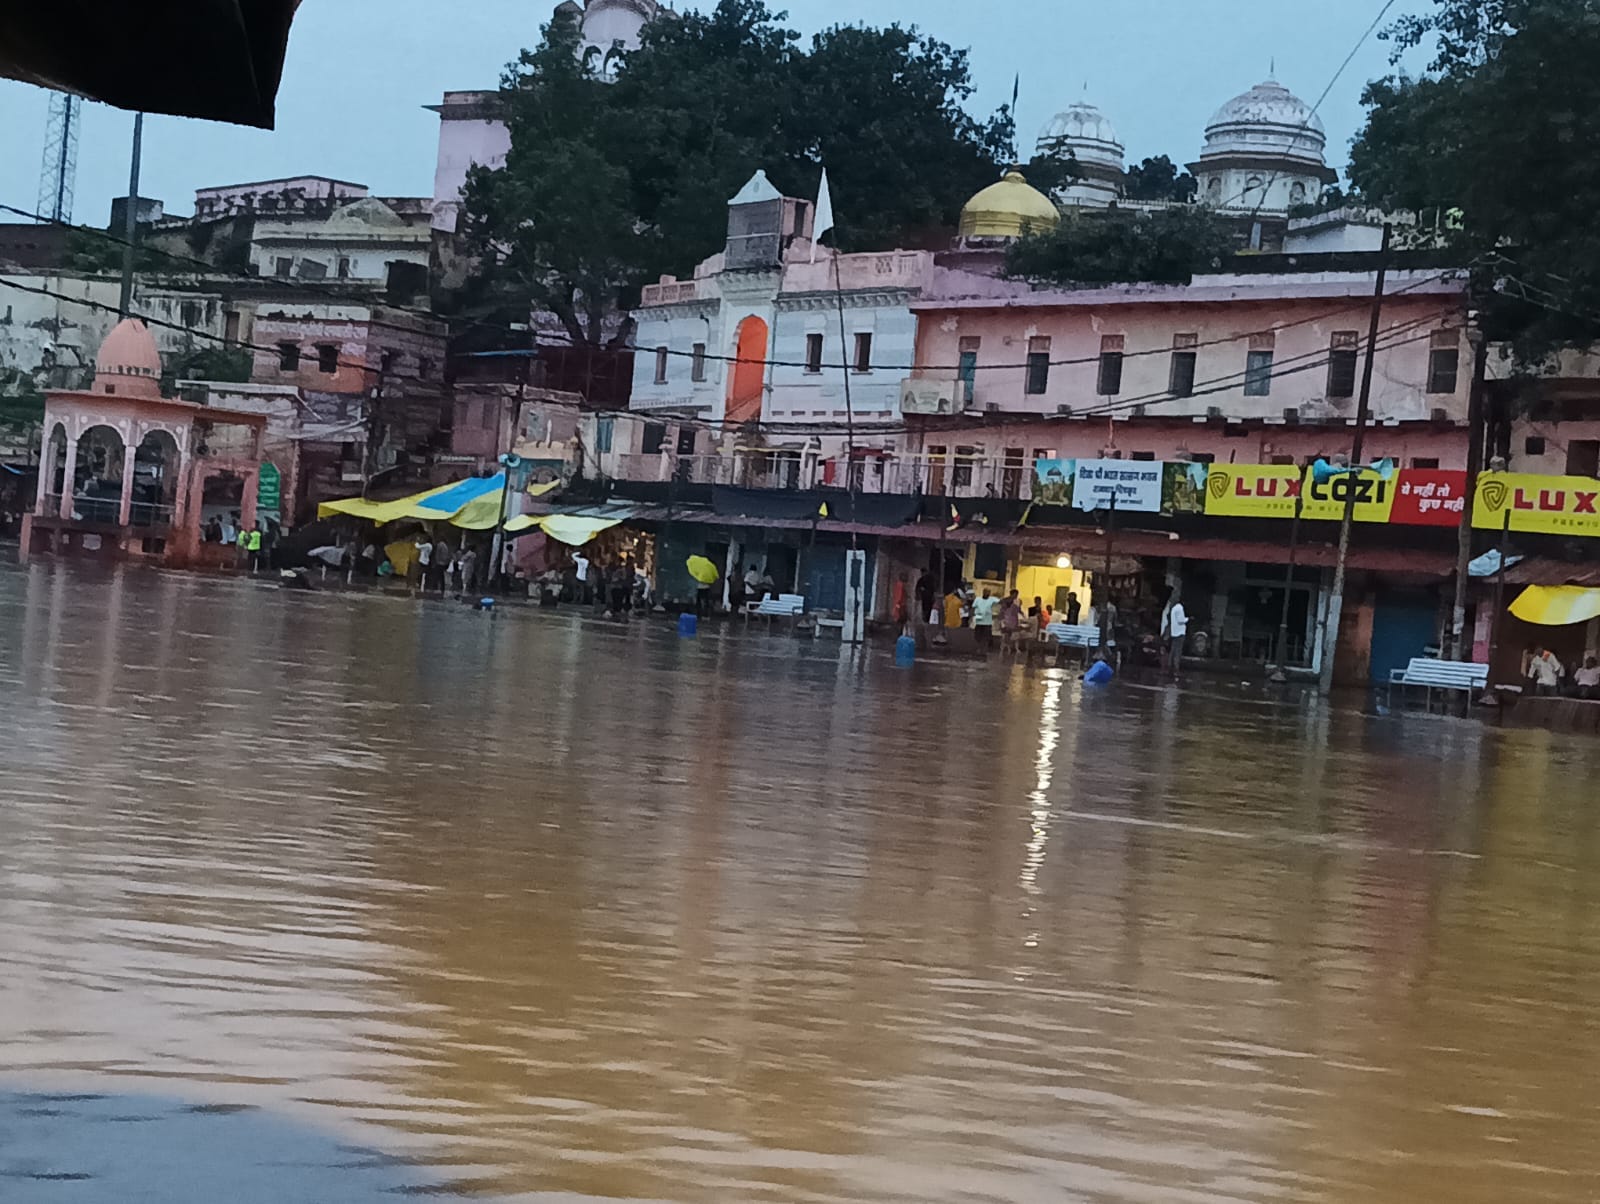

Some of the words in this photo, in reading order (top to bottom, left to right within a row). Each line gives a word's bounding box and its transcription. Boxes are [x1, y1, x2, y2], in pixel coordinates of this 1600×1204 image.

[1235, 477, 1301, 498] LUX
[1311, 477, 1387, 504] COZI
[1401, 481, 1411, 495] ये
[1436, 482, 1451, 497] तो
[1419, 498, 1442, 513] कुछ
[1514, 488, 1598, 514] LUX
